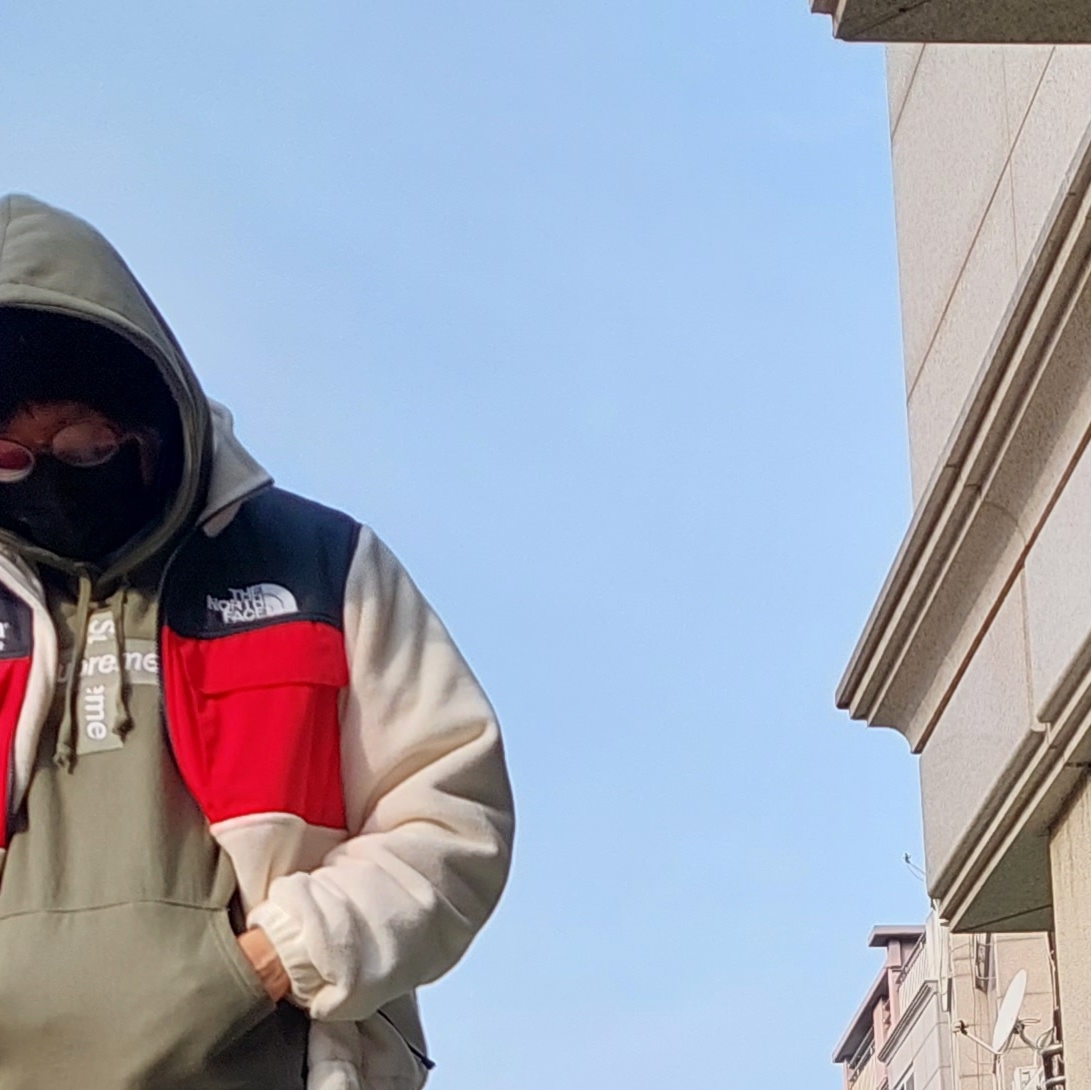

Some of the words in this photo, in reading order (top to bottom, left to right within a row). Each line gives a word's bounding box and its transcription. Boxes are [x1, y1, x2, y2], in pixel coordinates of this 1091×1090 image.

[228, 585, 263, 601] THE
[206, 593, 264, 612] NORTH
[223, 607, 267, 624] FACE
